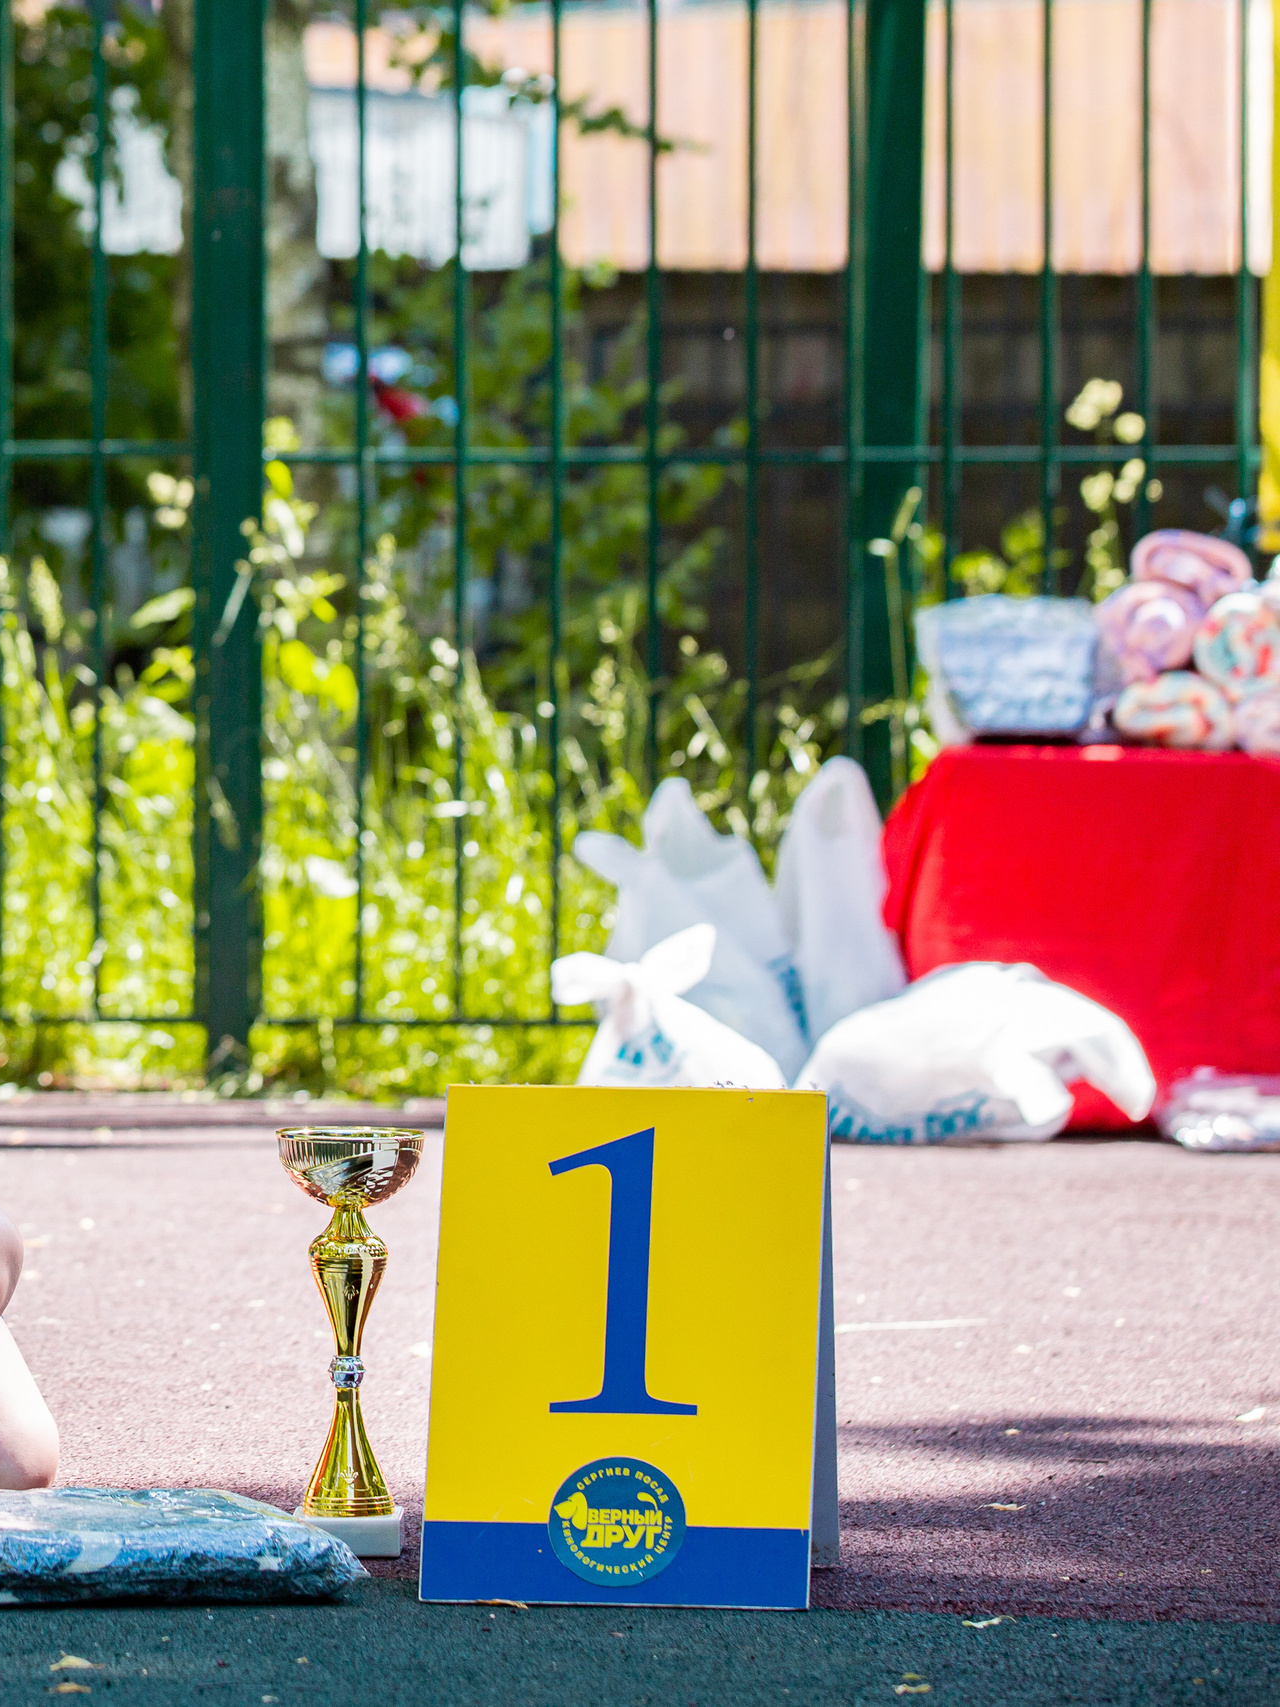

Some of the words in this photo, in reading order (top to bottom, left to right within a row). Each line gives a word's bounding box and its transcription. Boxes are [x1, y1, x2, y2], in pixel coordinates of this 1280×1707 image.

[548, 1126, 698, 1416] 1
[576, 1467, 631, 1491] СЕРГИЕВ
[634, 1471, 670, 1504] ПОСАД
[588, 1507, 663, 1526] ВЕРНЫЙ
[561, 1520, 655, 1575] КИНОЛОГИЧЕСКИЙ
[654, 1515, 673, 1554] ЦЕНТР
[580, 1524, 663, 1549] ДРУГ
